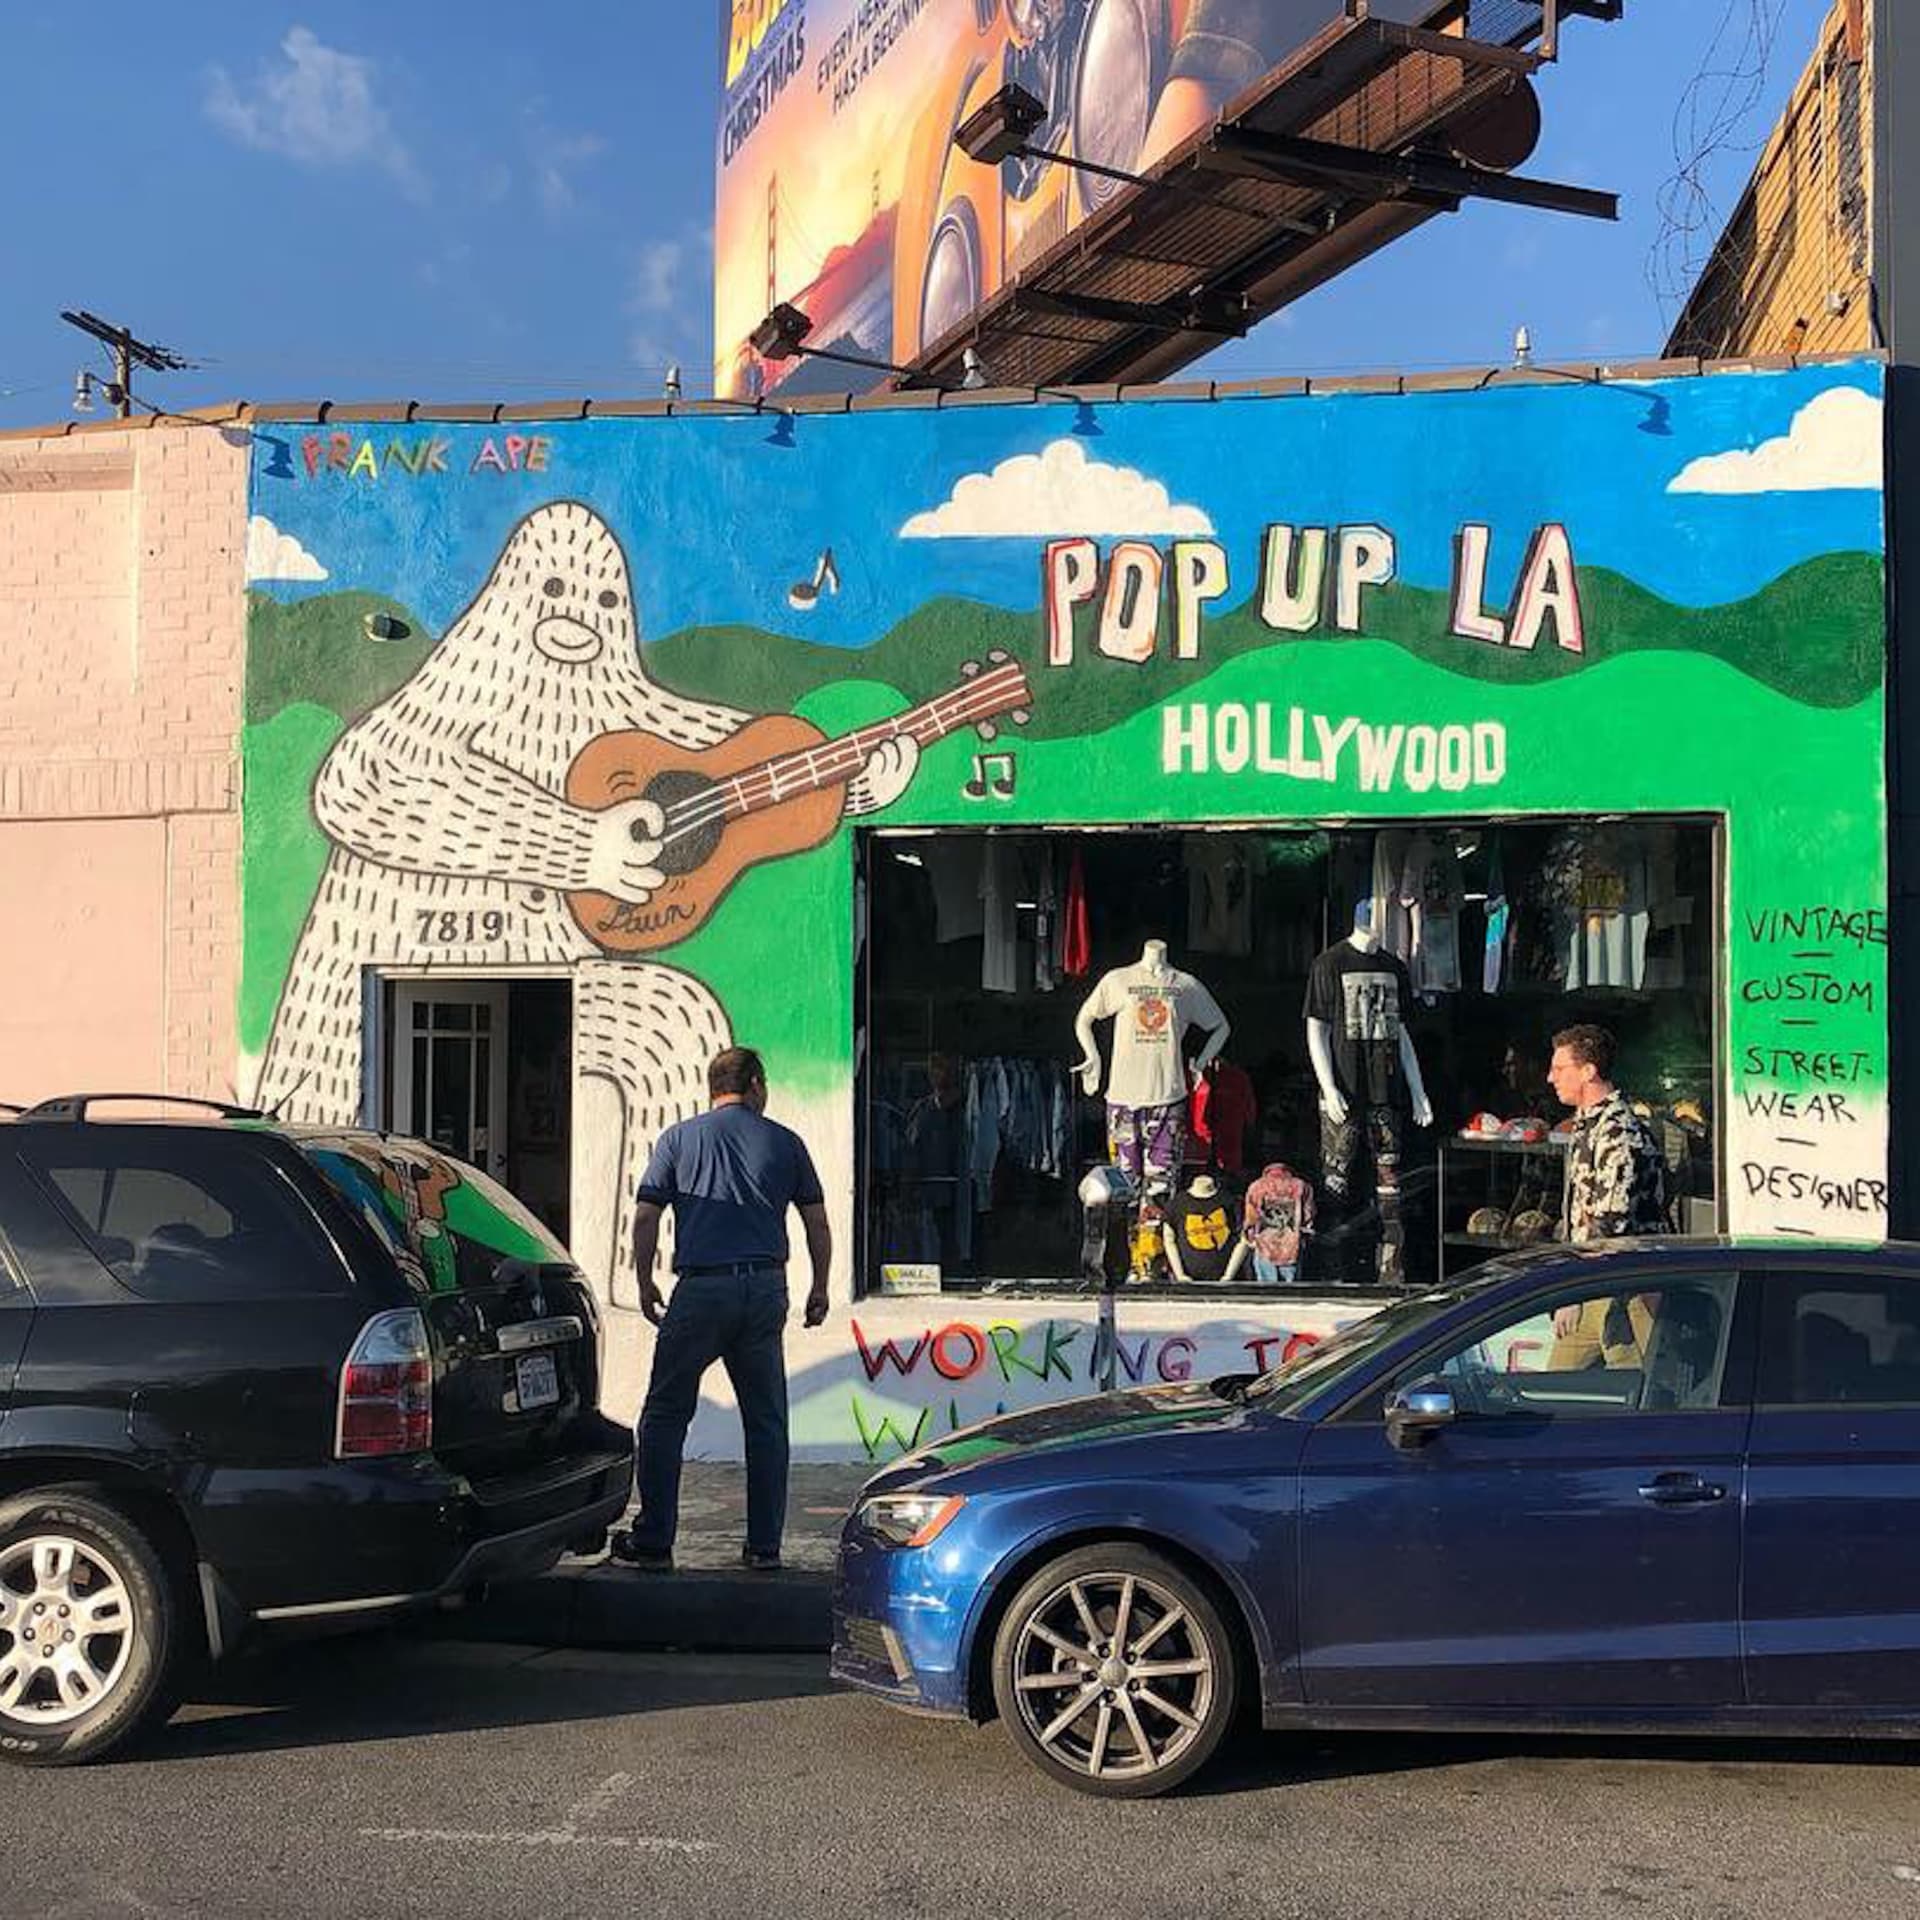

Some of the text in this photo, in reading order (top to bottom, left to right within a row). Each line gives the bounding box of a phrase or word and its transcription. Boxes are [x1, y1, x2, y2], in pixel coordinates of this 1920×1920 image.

[723, 15, 805, 166] CHRISTMAS
[833, 57, 858, 116] HAS
[860, 45, 869, 83] A
[471, 435, 552, 474] APE
[1043, 523, 1584, 668] POP UP LA
[1162, 702, 1506, 793] HOLLYWOOD
[416, 910, 503, 945] 7819
[1746, 907, 1889, 950] VINTAGE
[1743, 972, 1873, 1013] CUSTOM
[1742, 1088, 1857, 1122] WEAR
[1741, 1162, 1889, 1212] DESIGNER
[851, 1318, 1198, 1383] WORKING
